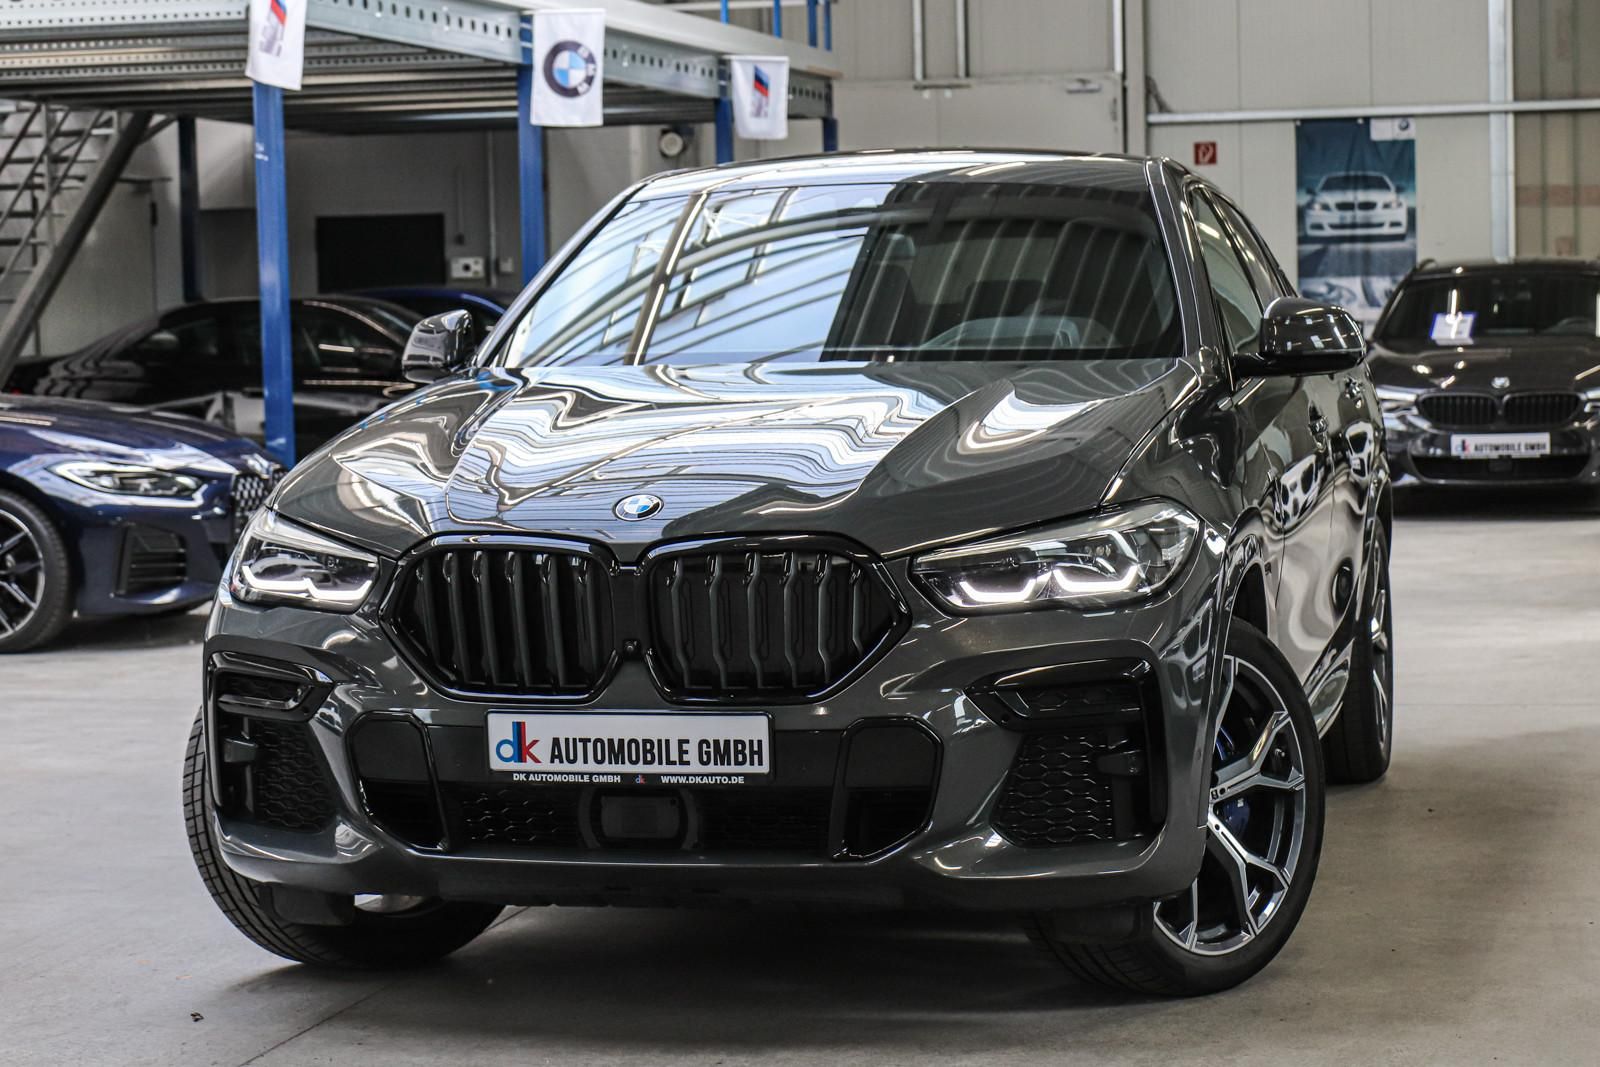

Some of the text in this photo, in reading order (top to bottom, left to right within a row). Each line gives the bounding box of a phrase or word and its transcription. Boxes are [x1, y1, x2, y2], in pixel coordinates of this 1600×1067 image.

[495, 721, 763, 767] dk AUTOMOBILE GMBH
[513, 773, 527, 781] DK
[528, 773, 590, 783] AUTOMOBILE
[592, 775, 621, 783] GMBH
[660, 775, 745, 784] WWW.DKAUTO.DE
